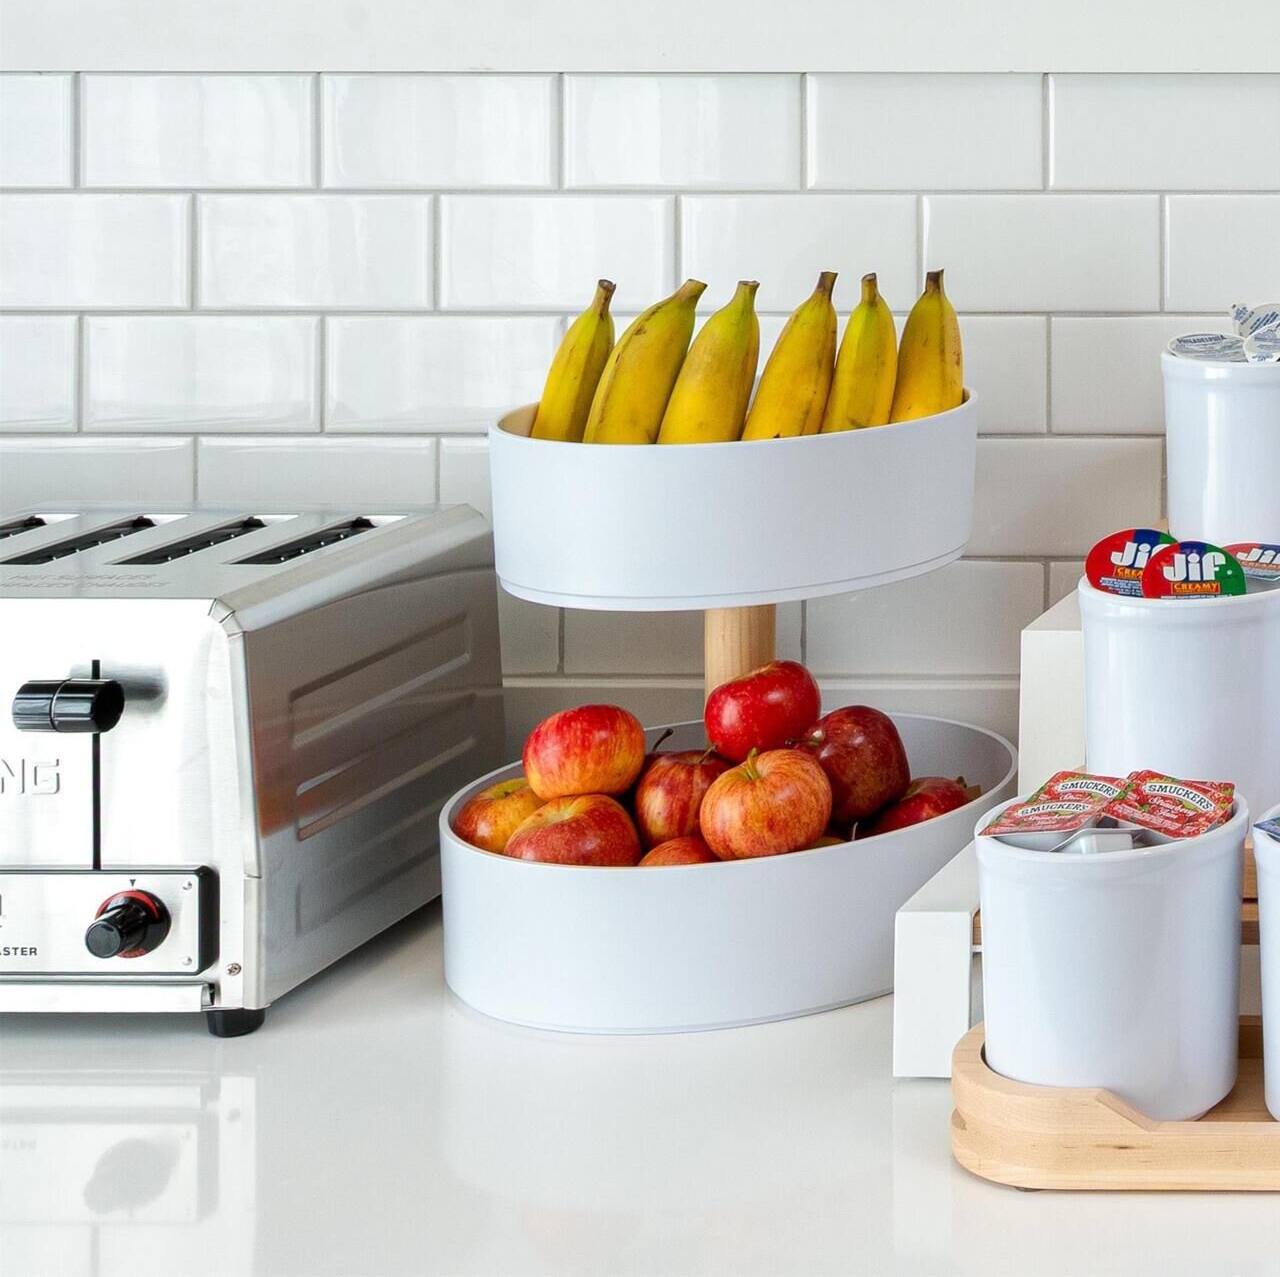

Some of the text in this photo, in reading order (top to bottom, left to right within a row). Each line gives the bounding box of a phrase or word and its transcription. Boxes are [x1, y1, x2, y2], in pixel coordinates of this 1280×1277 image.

[1162, 551, 1227, 582] Jif
[1173, 583, 1218, 591] CREAMY
[0, 946, 38, 957] STER
